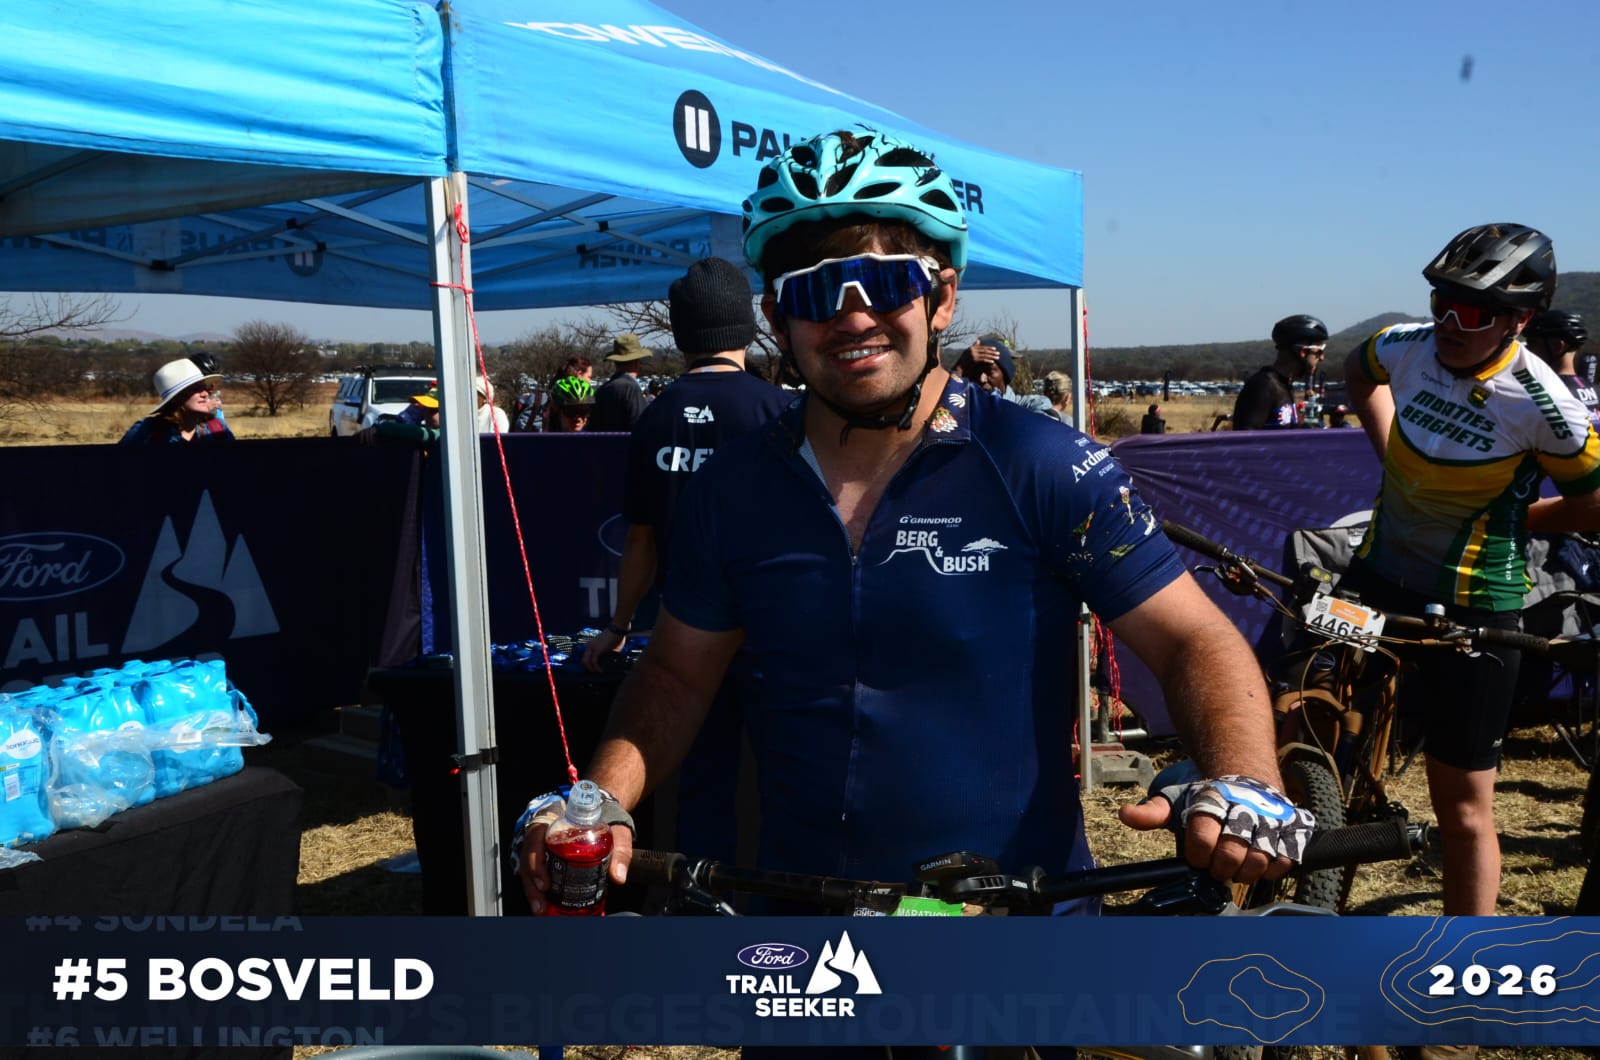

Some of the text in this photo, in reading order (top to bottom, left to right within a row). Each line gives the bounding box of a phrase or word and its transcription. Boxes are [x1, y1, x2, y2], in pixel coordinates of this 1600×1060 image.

[1512, 368, 1574, 440] MONTIES
[1401, 405, 1496, 452] BERGFIETS
[655, 446, 713, 473] CRE
[910, 517, 962, 525] GRINDROD
[895, 530, 938, 547] BERG
[934, 546, 944, 558] &
[0, 541, 93, 589] Ford
[943, 556, 990, 573] BUSH
[0, 611, 110, 669] AIL
[920, 859, 951, 872] GARMIN
